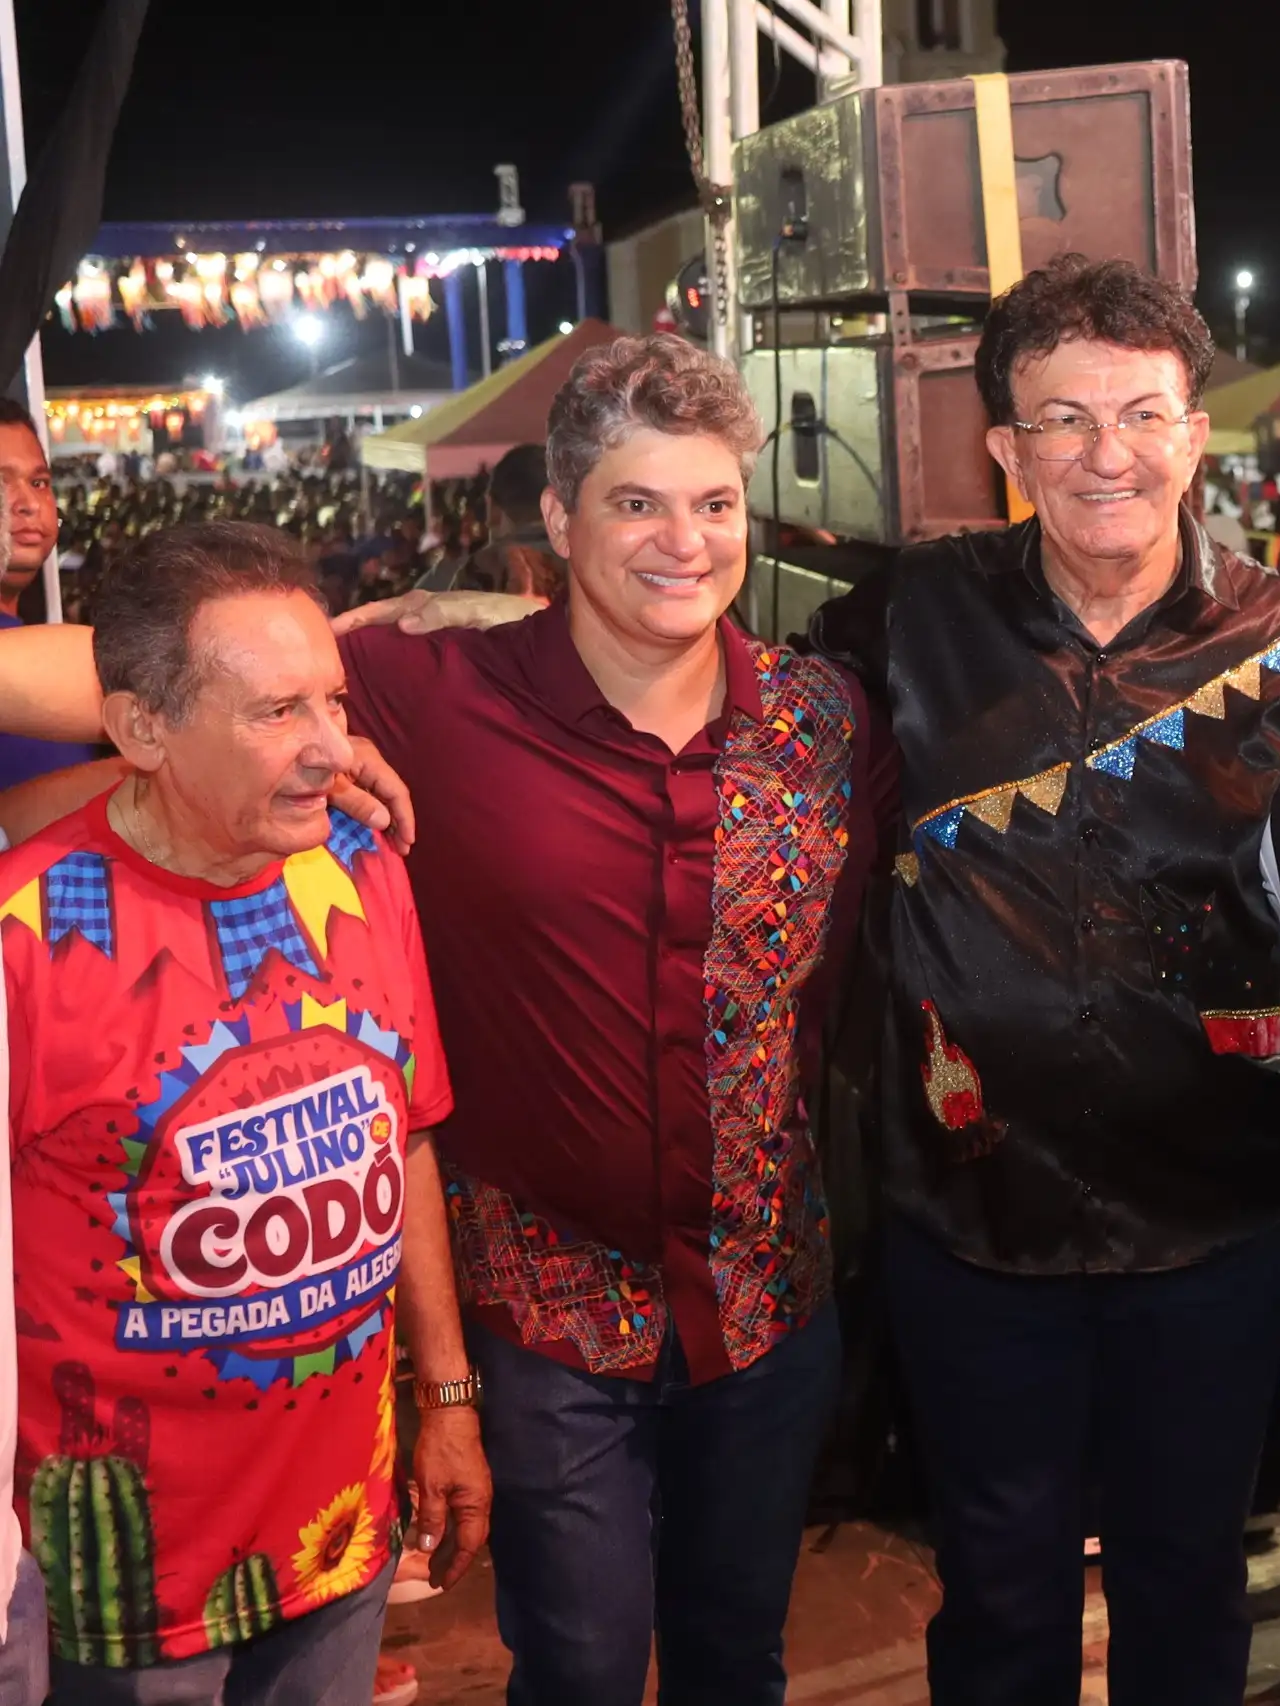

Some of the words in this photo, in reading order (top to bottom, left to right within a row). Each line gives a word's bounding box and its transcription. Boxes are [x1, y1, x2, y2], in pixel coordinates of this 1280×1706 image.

[186, 1076, 379, 1174] FESTIVAL
[373, 1120, 390, 1138] DE
[171, 1142, 400, 1288] CODÓ
[123, 1308, 149, 1338] A
[161, 1296, 290, 1338] PEGADA
[300, 1280, 336, 1319] DA
